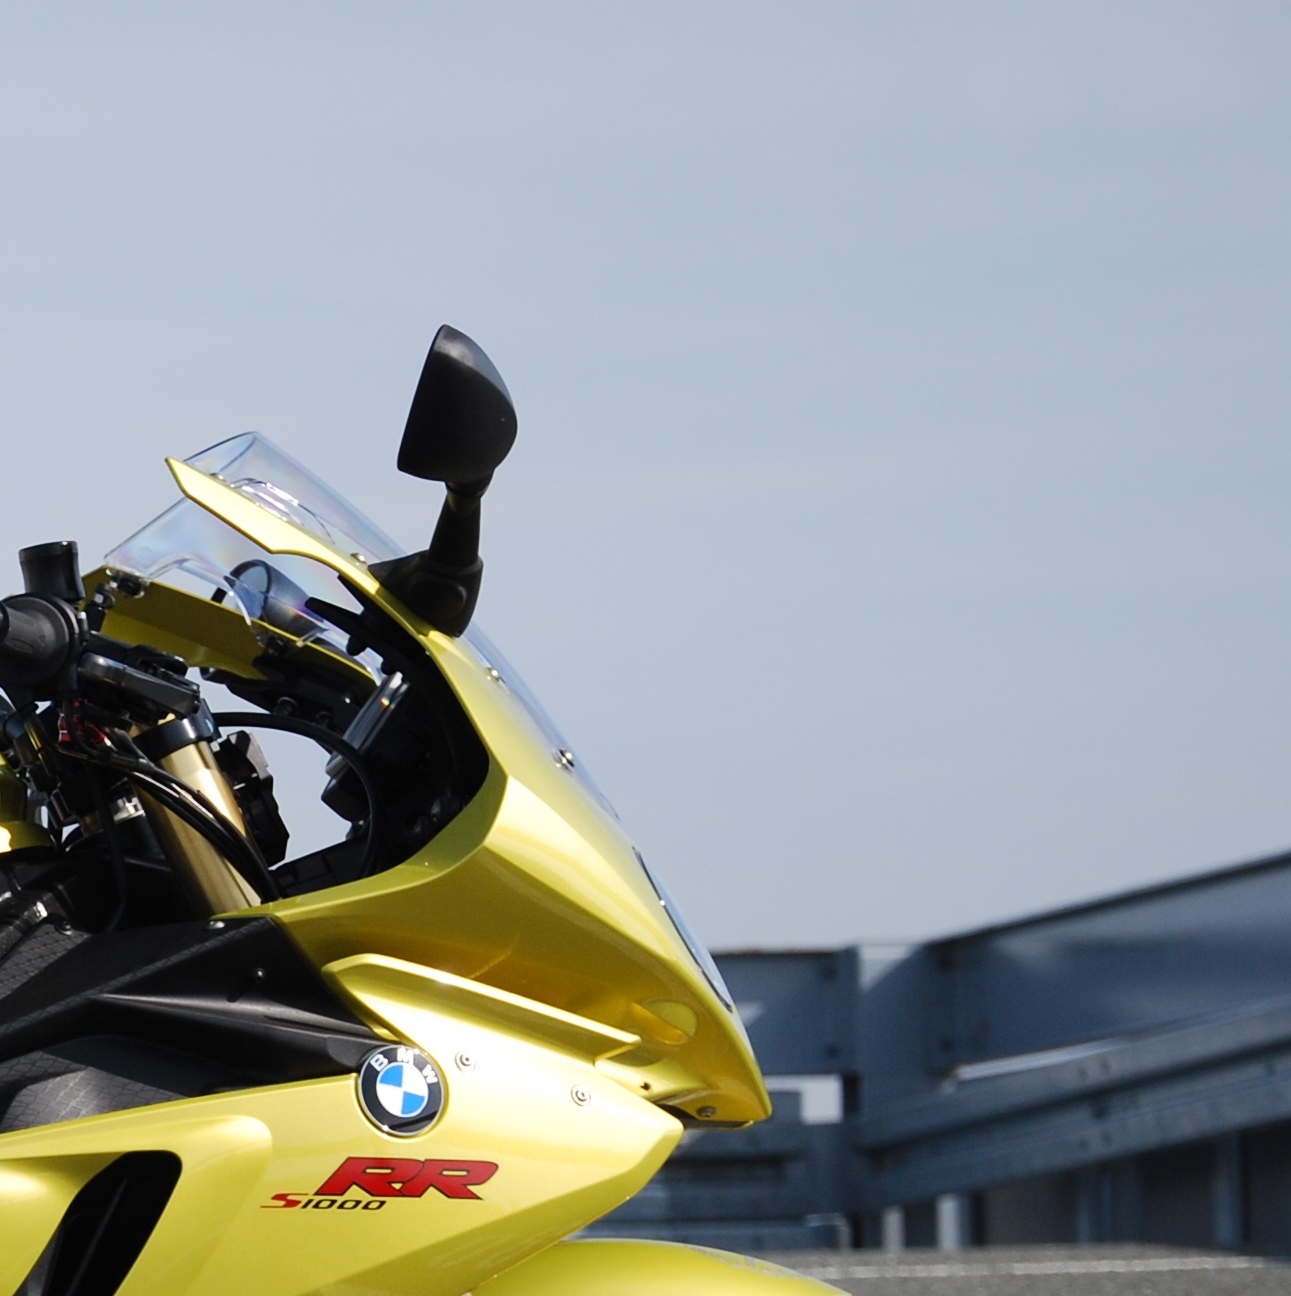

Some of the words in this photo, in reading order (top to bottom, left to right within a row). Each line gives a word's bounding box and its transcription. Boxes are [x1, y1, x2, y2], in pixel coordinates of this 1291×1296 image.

[370, 1047, 438, 1085] BMW
[312, 1156, 499, 1200] RR
[260, 1192, 387, 1211] S1000
